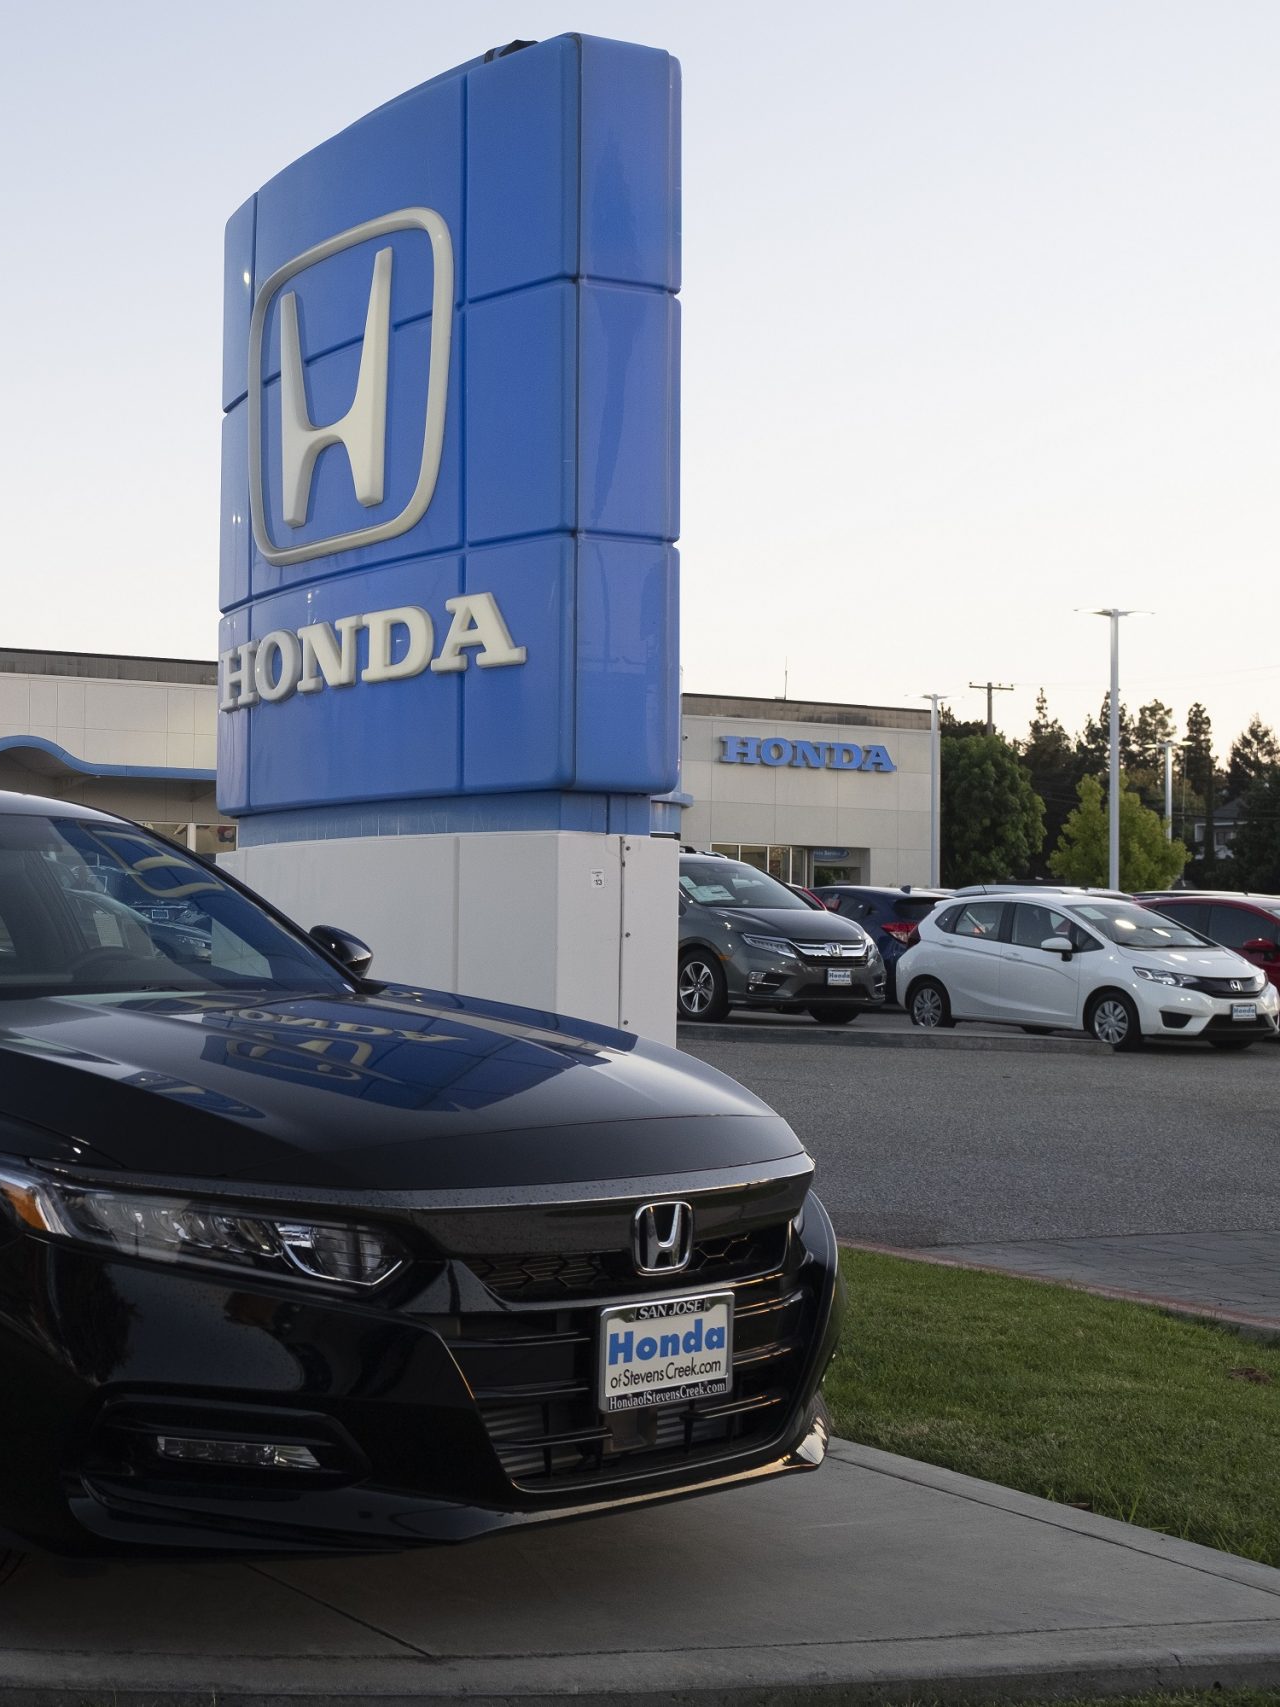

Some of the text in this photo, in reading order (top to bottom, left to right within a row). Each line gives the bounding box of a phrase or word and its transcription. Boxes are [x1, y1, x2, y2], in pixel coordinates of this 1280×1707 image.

[220, 591, 527, 713] HONDA
[719, 736, 897, 773] HONDA
[638, 1299, 702, 1320] SAN JOSE
[608, 1318, 726, 1366] Honda
[609, 1382, 726, 1410] HondaofStevensCreek.com
